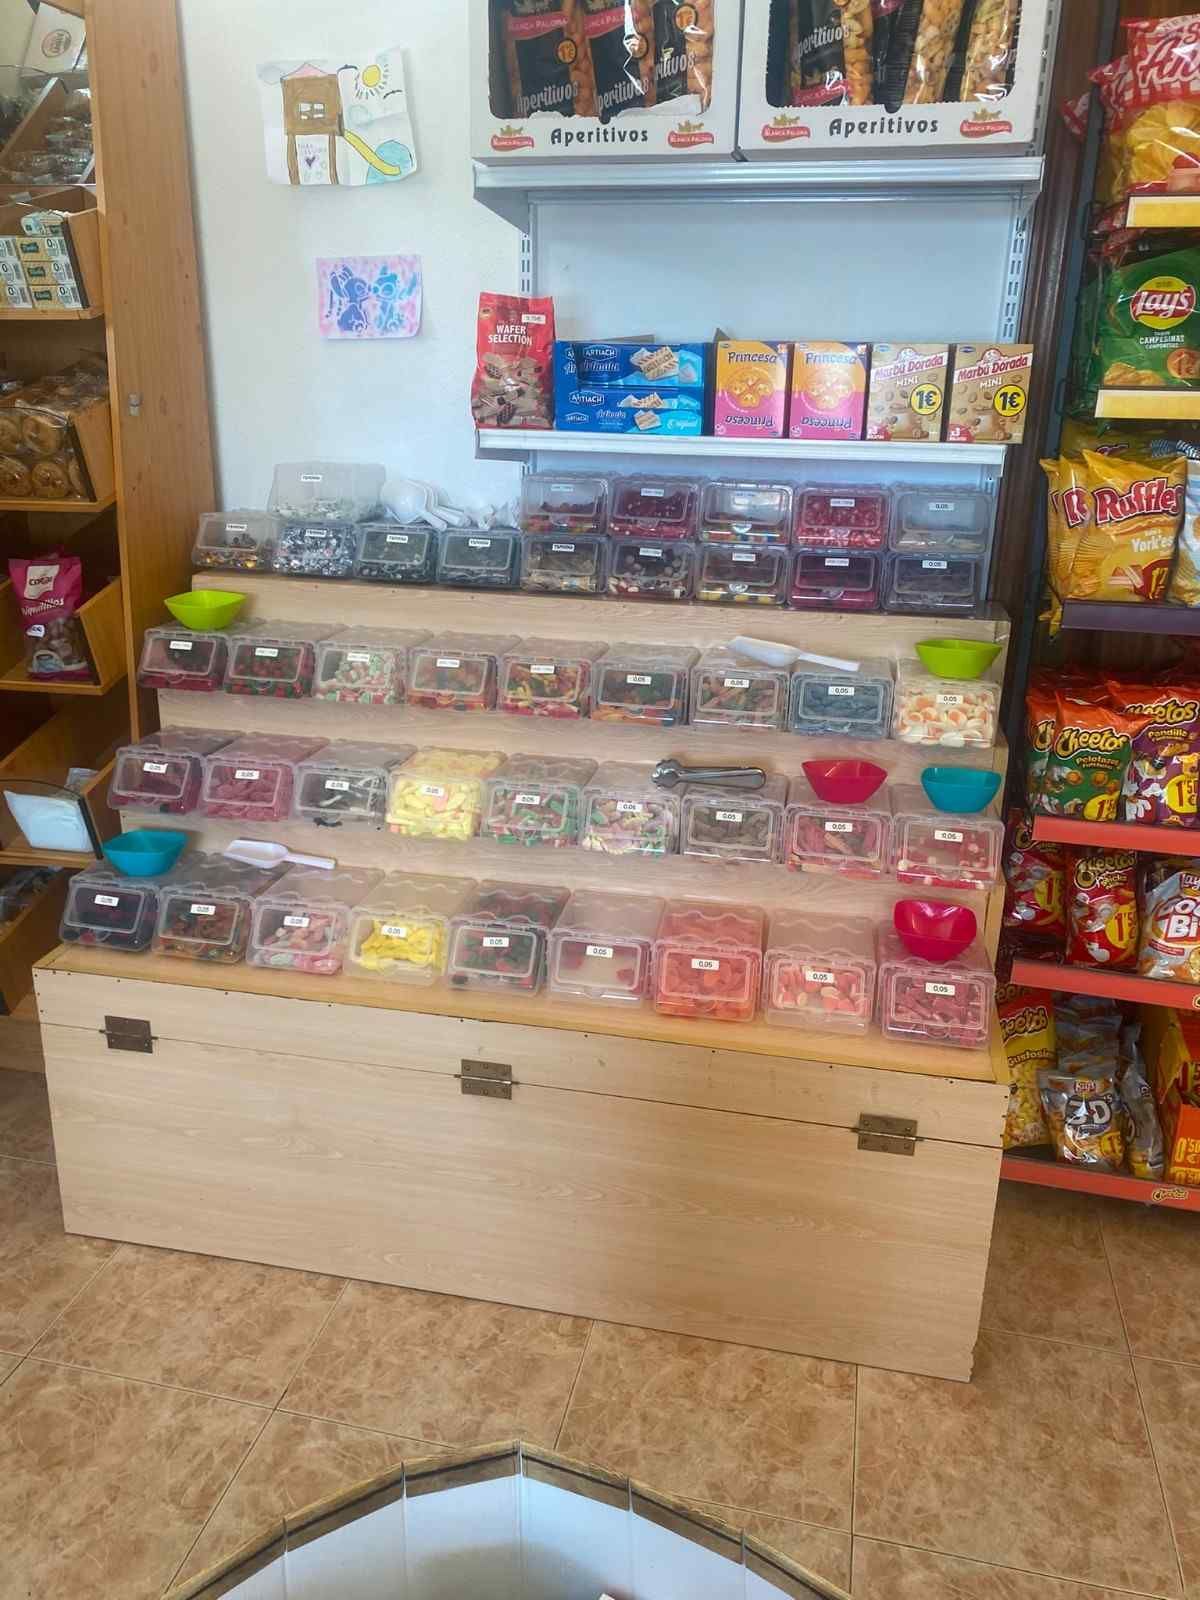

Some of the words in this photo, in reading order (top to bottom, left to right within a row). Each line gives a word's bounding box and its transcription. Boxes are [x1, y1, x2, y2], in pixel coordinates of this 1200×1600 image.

[829, 117, 938, 138] Aperitivos
[550, 127, 648, 147] Aperitivos
[496, 324, 526, 335] WAFER
[488, 334, 532, 346] SELECTION
[728, 352, 778, 364] Princesa
[908, 355, 944, 373] Dorada
[992, 356, 1028, 373] Dorada
[916, 390, 938, 409] 1€
[1000, 391, 1021, 411] 1€
[1056, 727, 1129, 758] Cheetos
